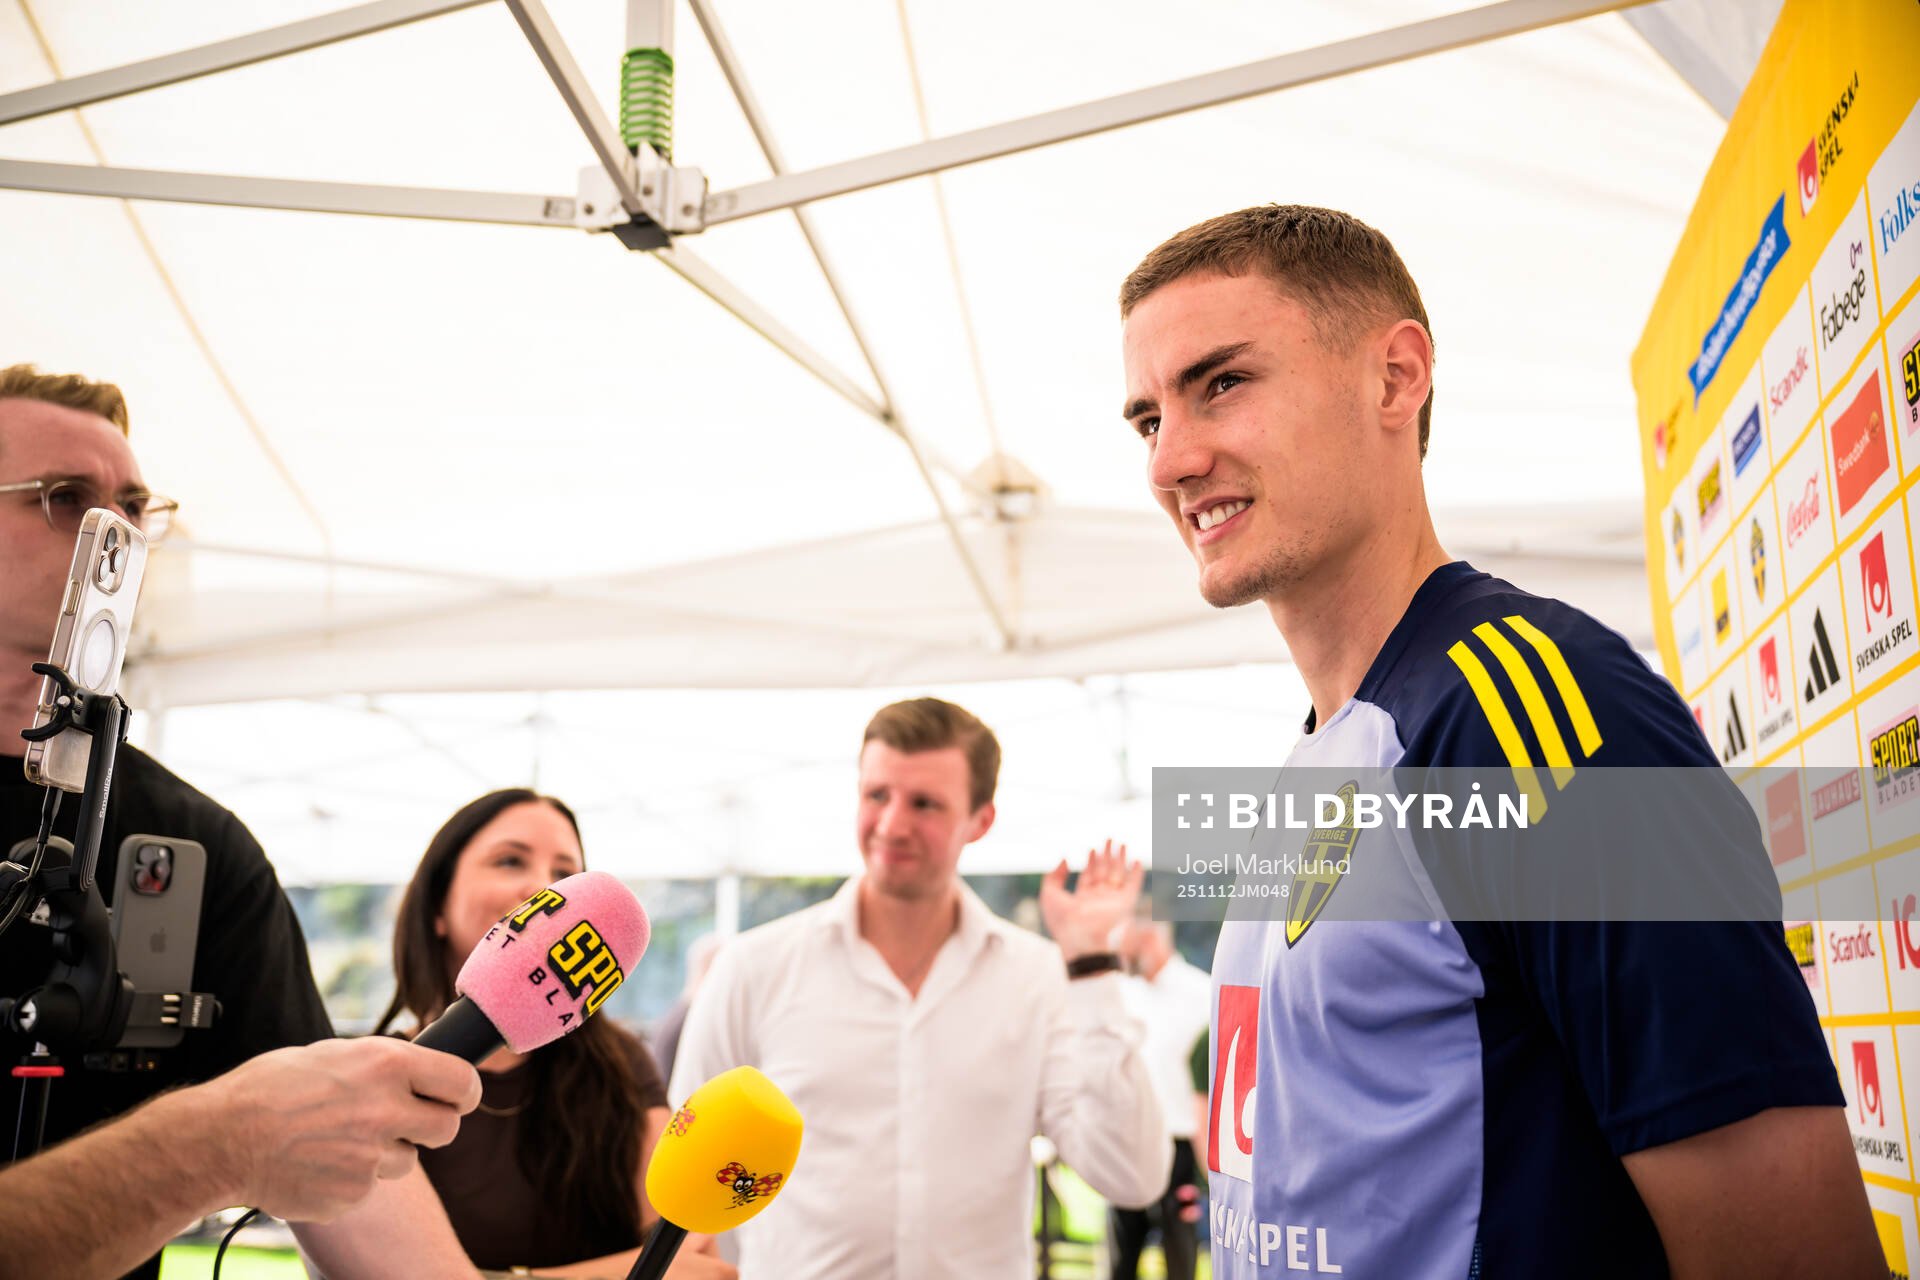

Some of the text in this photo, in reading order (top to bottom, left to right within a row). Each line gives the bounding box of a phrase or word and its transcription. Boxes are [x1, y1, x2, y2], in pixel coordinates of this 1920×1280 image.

[1818, 70, 1858, 158] SVENSKA
[1820, 136, 1843, 184] SPEL
[1821, 269, 1865, 350] Fabege
[1856, 619, 1912, 673] SVENSKA SPEL
[1871, 714, 1920, 788] SPORT
[1313, 829, 1347, 841] SVERIGE
[1830, 923, 1875, 964] Scandic
[528, 966, 577, 1036] BLA
